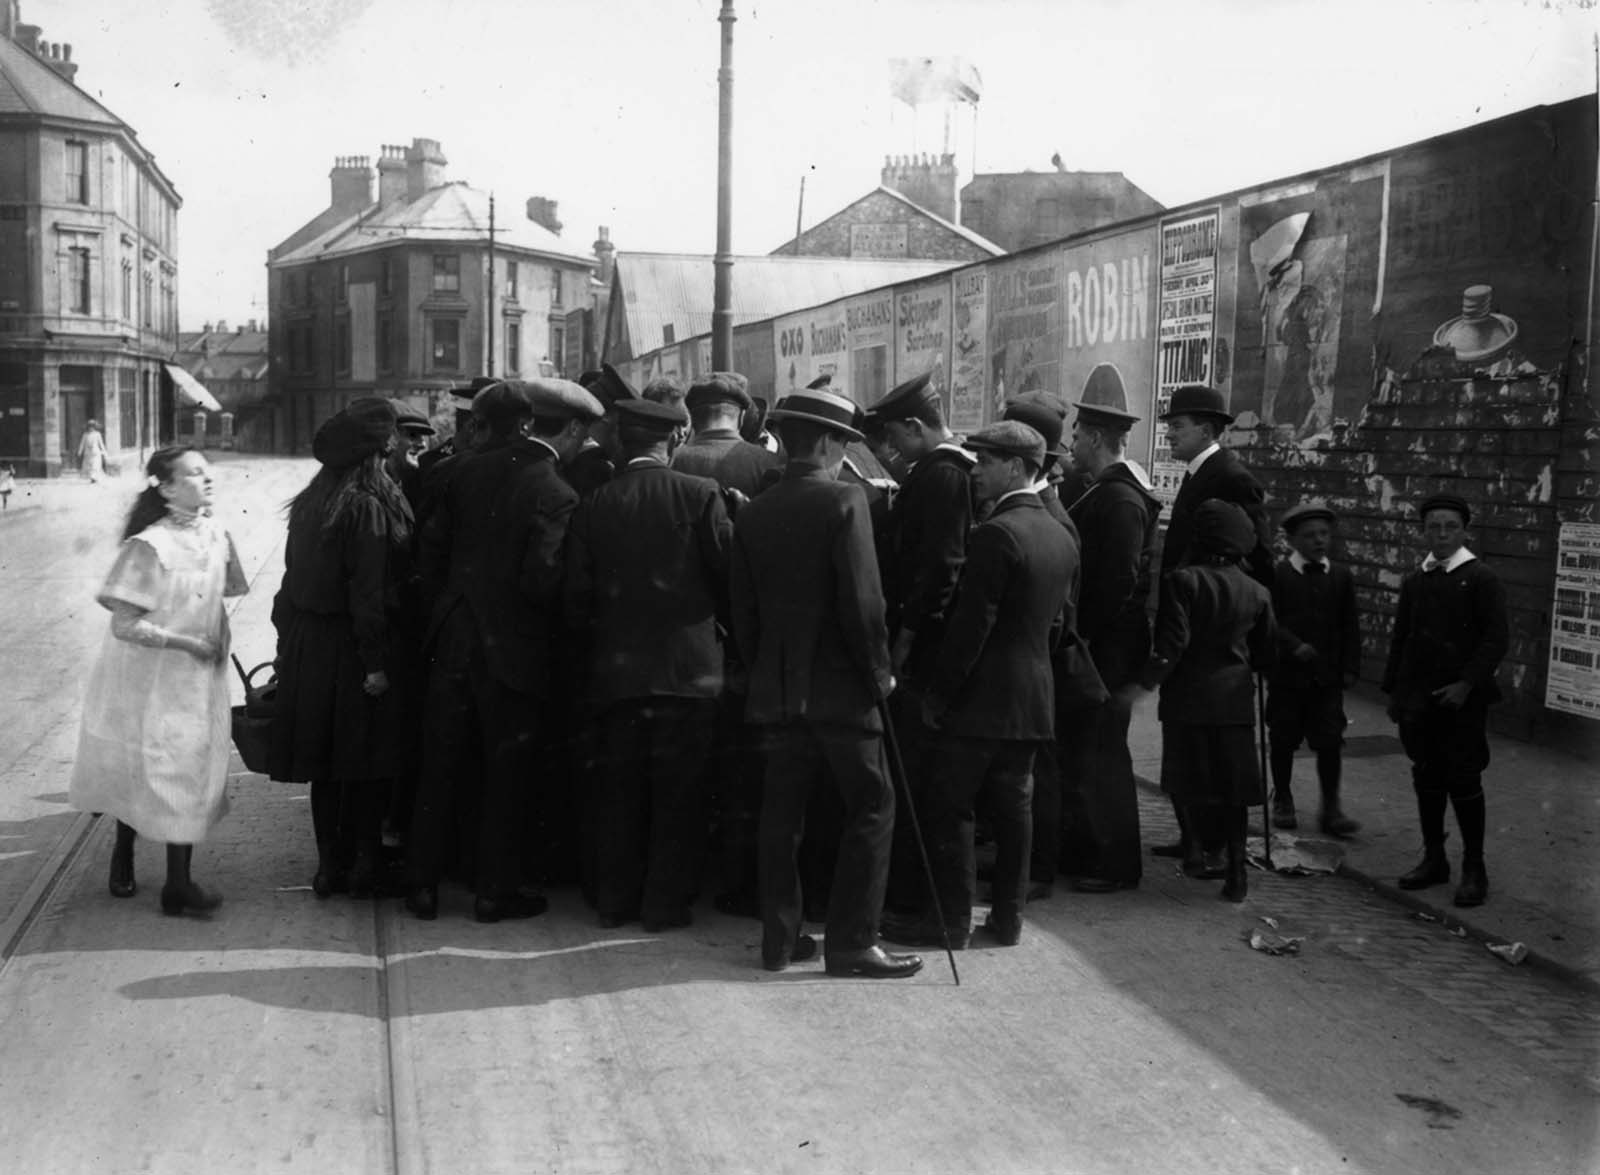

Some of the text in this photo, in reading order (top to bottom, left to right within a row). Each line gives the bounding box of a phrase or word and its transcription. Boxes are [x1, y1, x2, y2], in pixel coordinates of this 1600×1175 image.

[899, 293, 943, 330] Skipper
[1067, 255, 1148, 348] ROBIN
[780, 327, 804, 358] OXO
[1163, 337, 1208, 384] TITANIC
